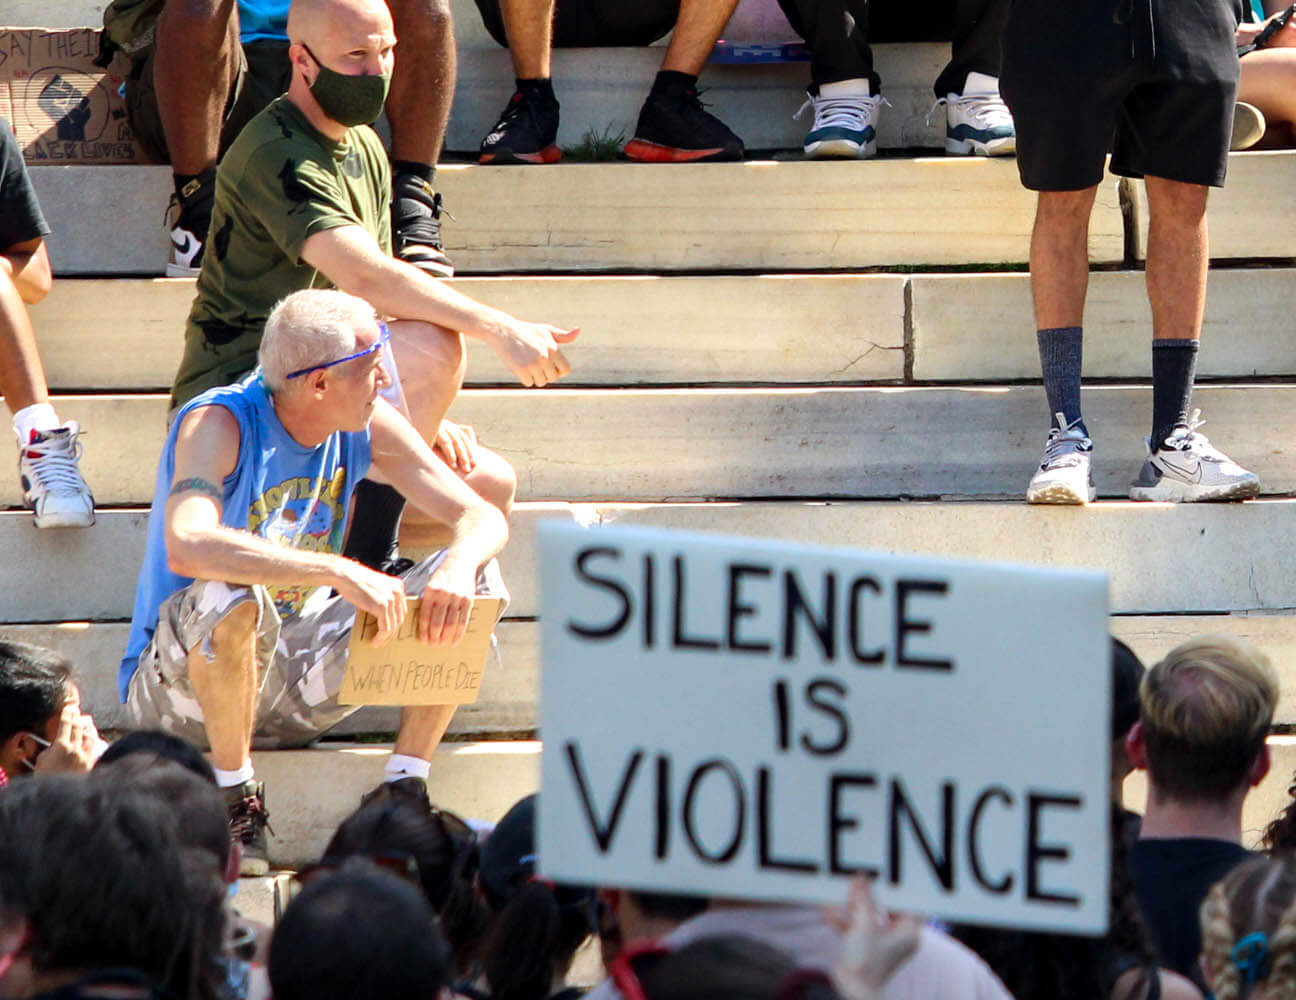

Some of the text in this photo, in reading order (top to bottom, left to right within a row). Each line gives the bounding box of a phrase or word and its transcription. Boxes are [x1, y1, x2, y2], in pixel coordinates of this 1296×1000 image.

[567, 545, 956, 671] SILENCE
[771, 678, 852, 757] IS
[563, 738, 1084, 907] VIOLENCE
